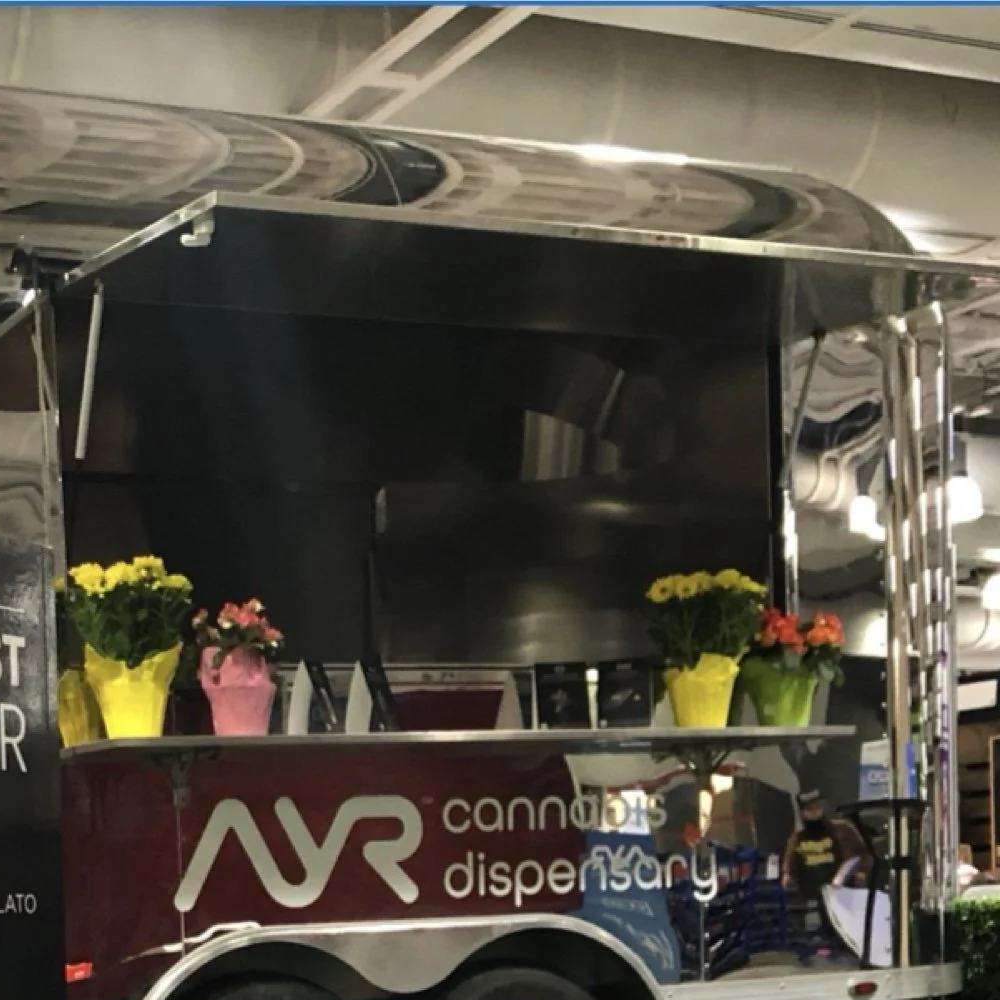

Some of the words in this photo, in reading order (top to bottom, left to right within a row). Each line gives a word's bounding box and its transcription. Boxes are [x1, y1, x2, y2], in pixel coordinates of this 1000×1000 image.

[442, 788, 667, 834] cannabis
[174, 794, 424, 912] AYR
[444, 851, 718, 908] dispensary
